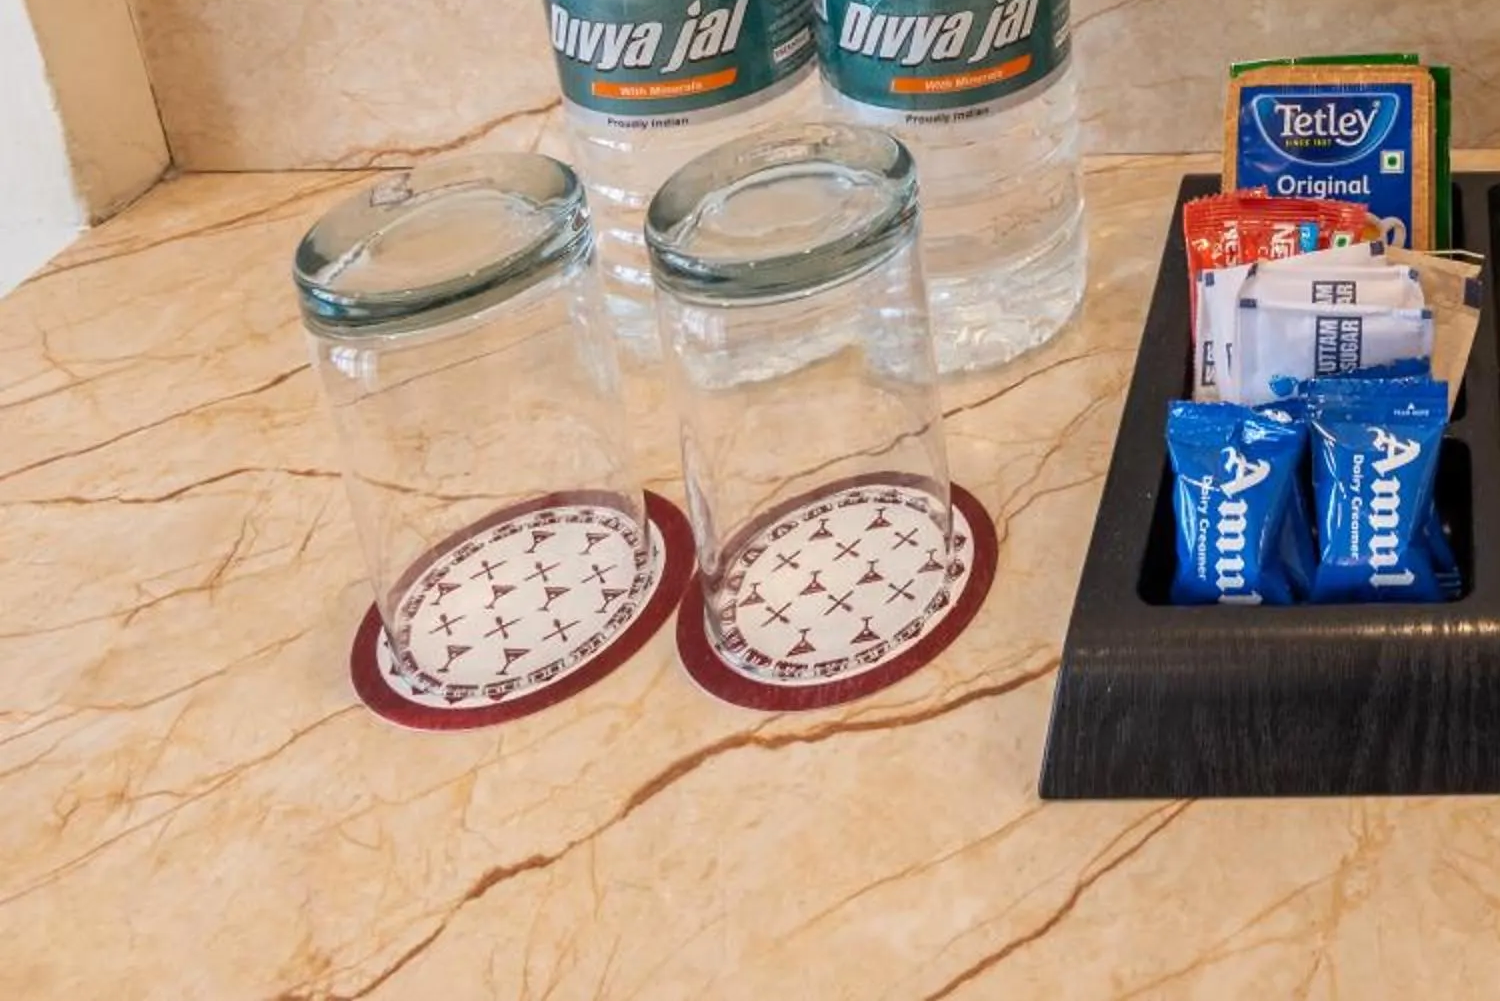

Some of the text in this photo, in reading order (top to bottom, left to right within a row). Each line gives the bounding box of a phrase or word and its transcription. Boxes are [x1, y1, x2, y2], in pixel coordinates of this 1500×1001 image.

[551, 3, 664, 73] Divya
[839, 1, 973, 67] Divya
[620, 81, 703, 96] With Minerals
[905, 107, 990, 125] Proudly Indian
[607, 116, 689, 130] Proudly Indian
[1274, 102, 1379, 146] Tetley
[1276, 174, 1371, 198] Original
[1317, 319, 1339, 374] UTTAM
[1341, 319, 1360, 374] SUGAR
[1215, 446, 1271, 605] Amul
[1350, 454, 1365, 559] Dairy Creamer
[1366, 426, 1421, 589] Amul
[1198, 517, 1211, 580] Creamer
